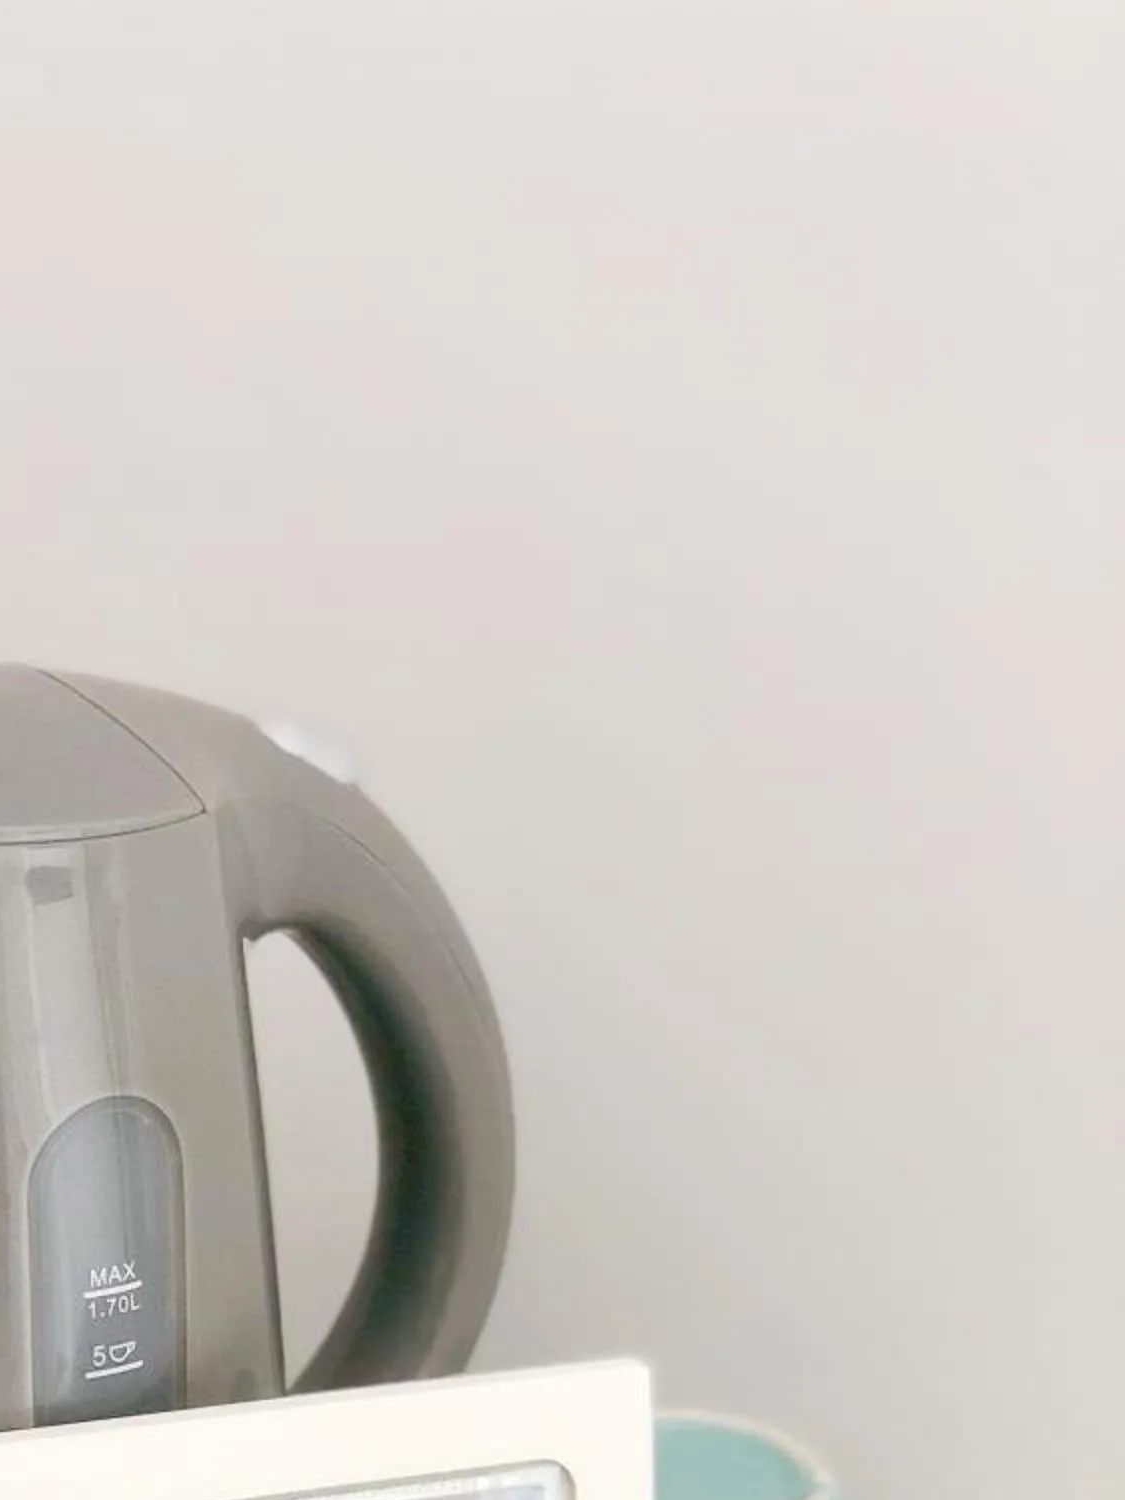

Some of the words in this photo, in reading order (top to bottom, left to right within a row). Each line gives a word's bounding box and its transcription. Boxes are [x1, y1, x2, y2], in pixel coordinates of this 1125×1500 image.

[90, 1260, 136, 1287] MAX
[88, 1293, 140, 1318] 1.70L
[92, 1345, 106, 1367] 5
